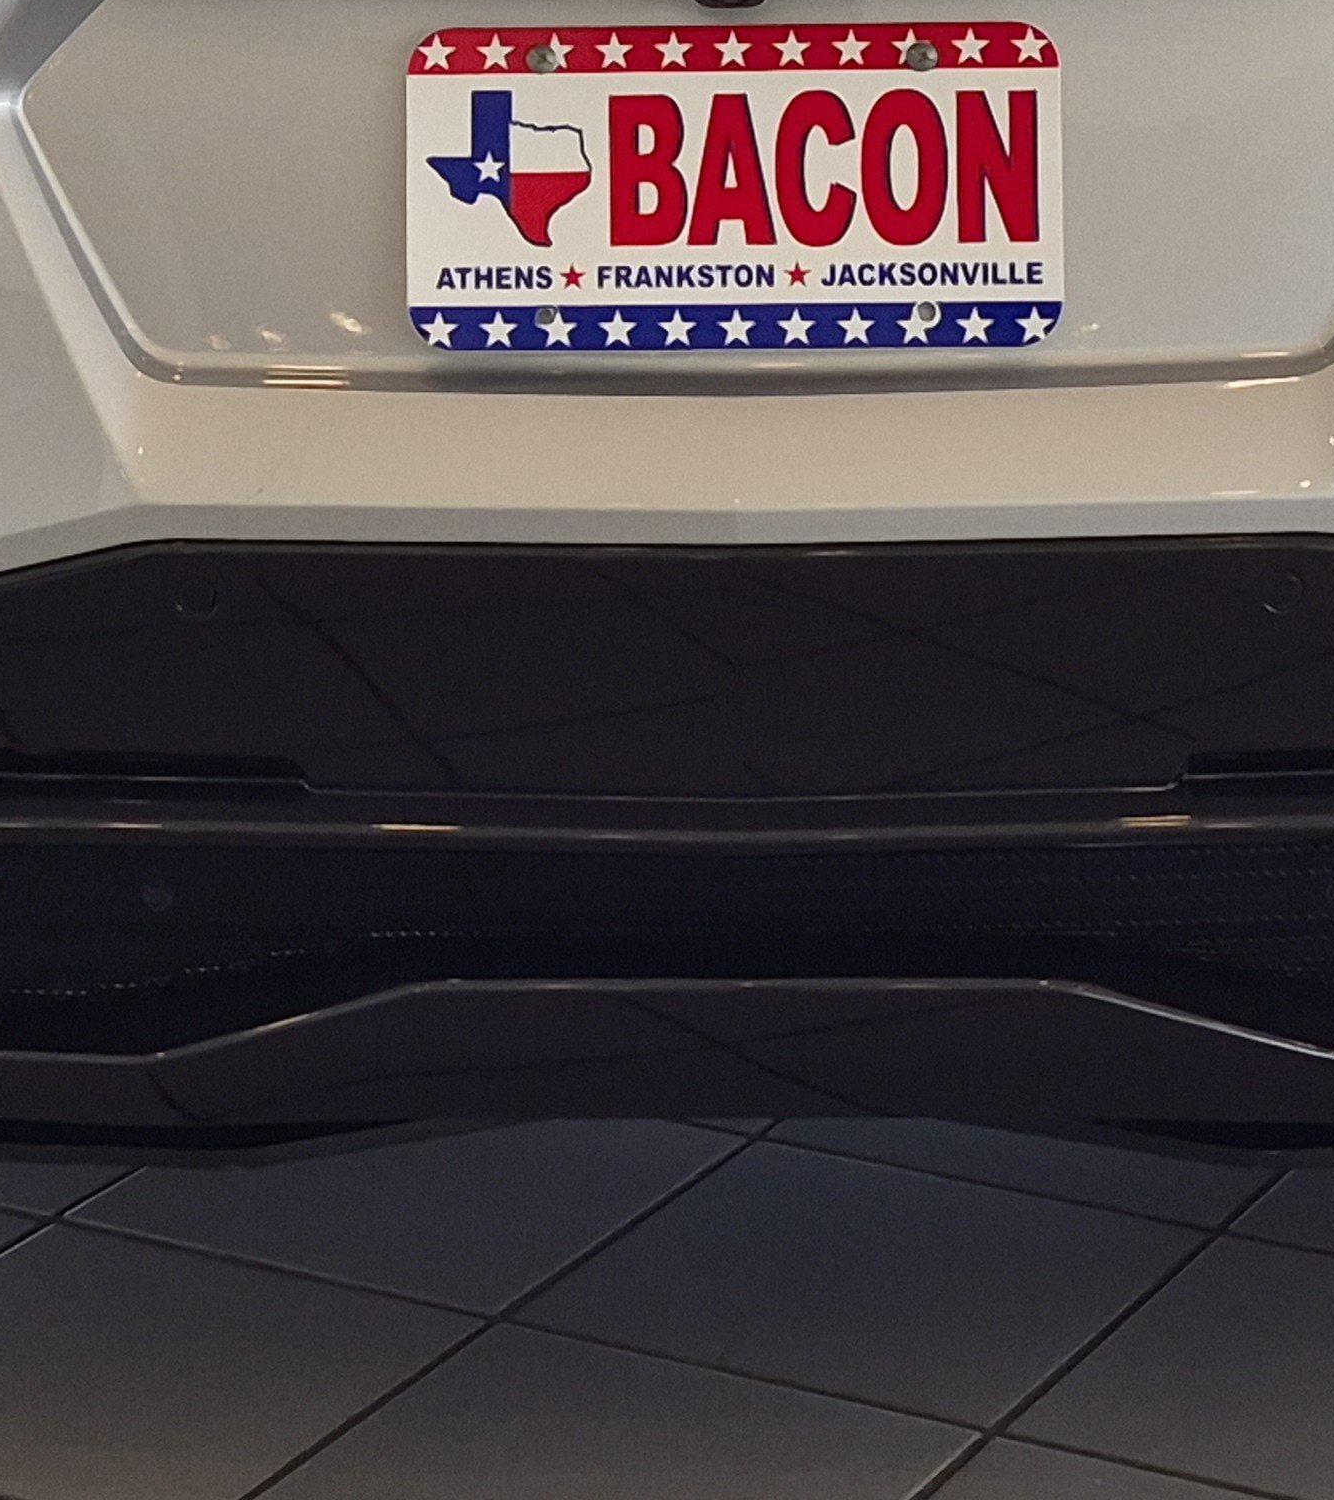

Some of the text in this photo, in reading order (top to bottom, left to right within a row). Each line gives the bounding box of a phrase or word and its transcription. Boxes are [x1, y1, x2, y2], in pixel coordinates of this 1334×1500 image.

[608, 88, 1040, 247] BACON
[435, 262, 1044, 291] ATHENS FRANKSTON JACKSONVILLE
